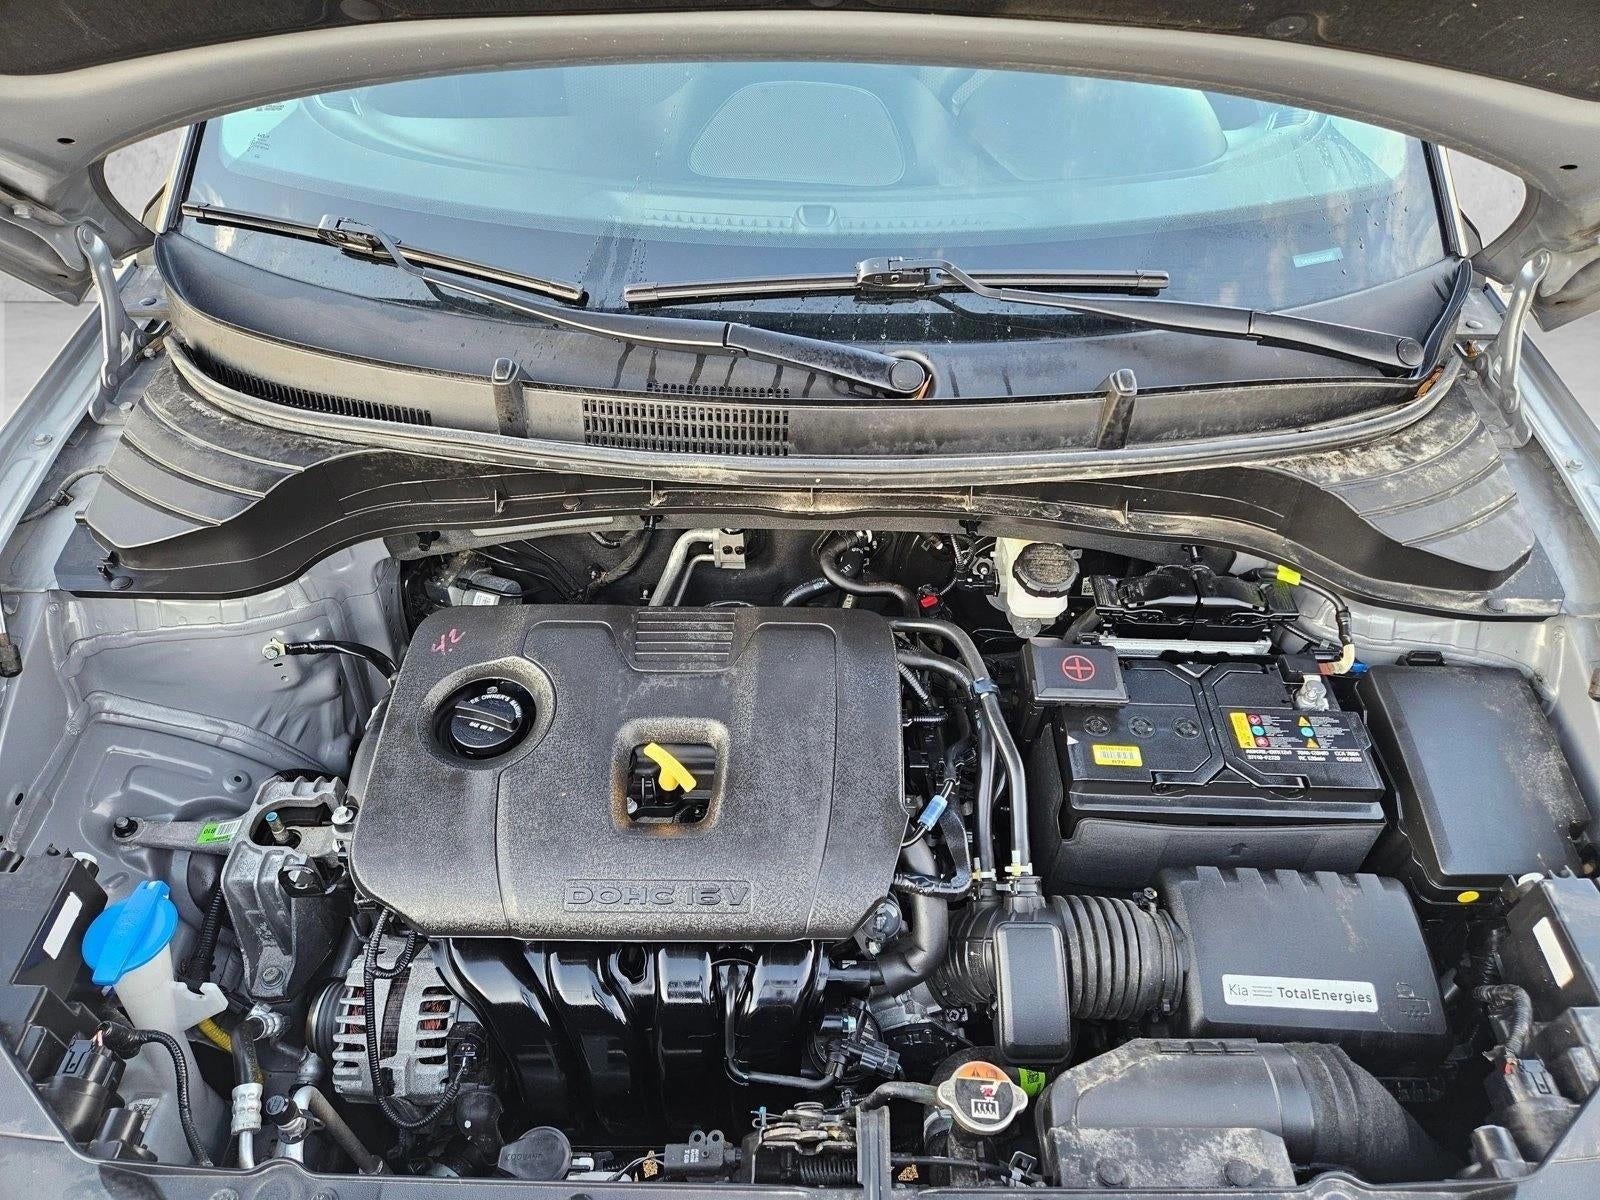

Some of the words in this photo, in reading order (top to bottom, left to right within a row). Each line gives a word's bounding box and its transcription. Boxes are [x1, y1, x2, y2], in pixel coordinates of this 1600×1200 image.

[566, 886, 675, 906] DOHC
[686, 886, 749, 906] 16V
[1229, 983, 1249, 997] Kia
[1277, 987, 1372, 1004] TotalEnergies
